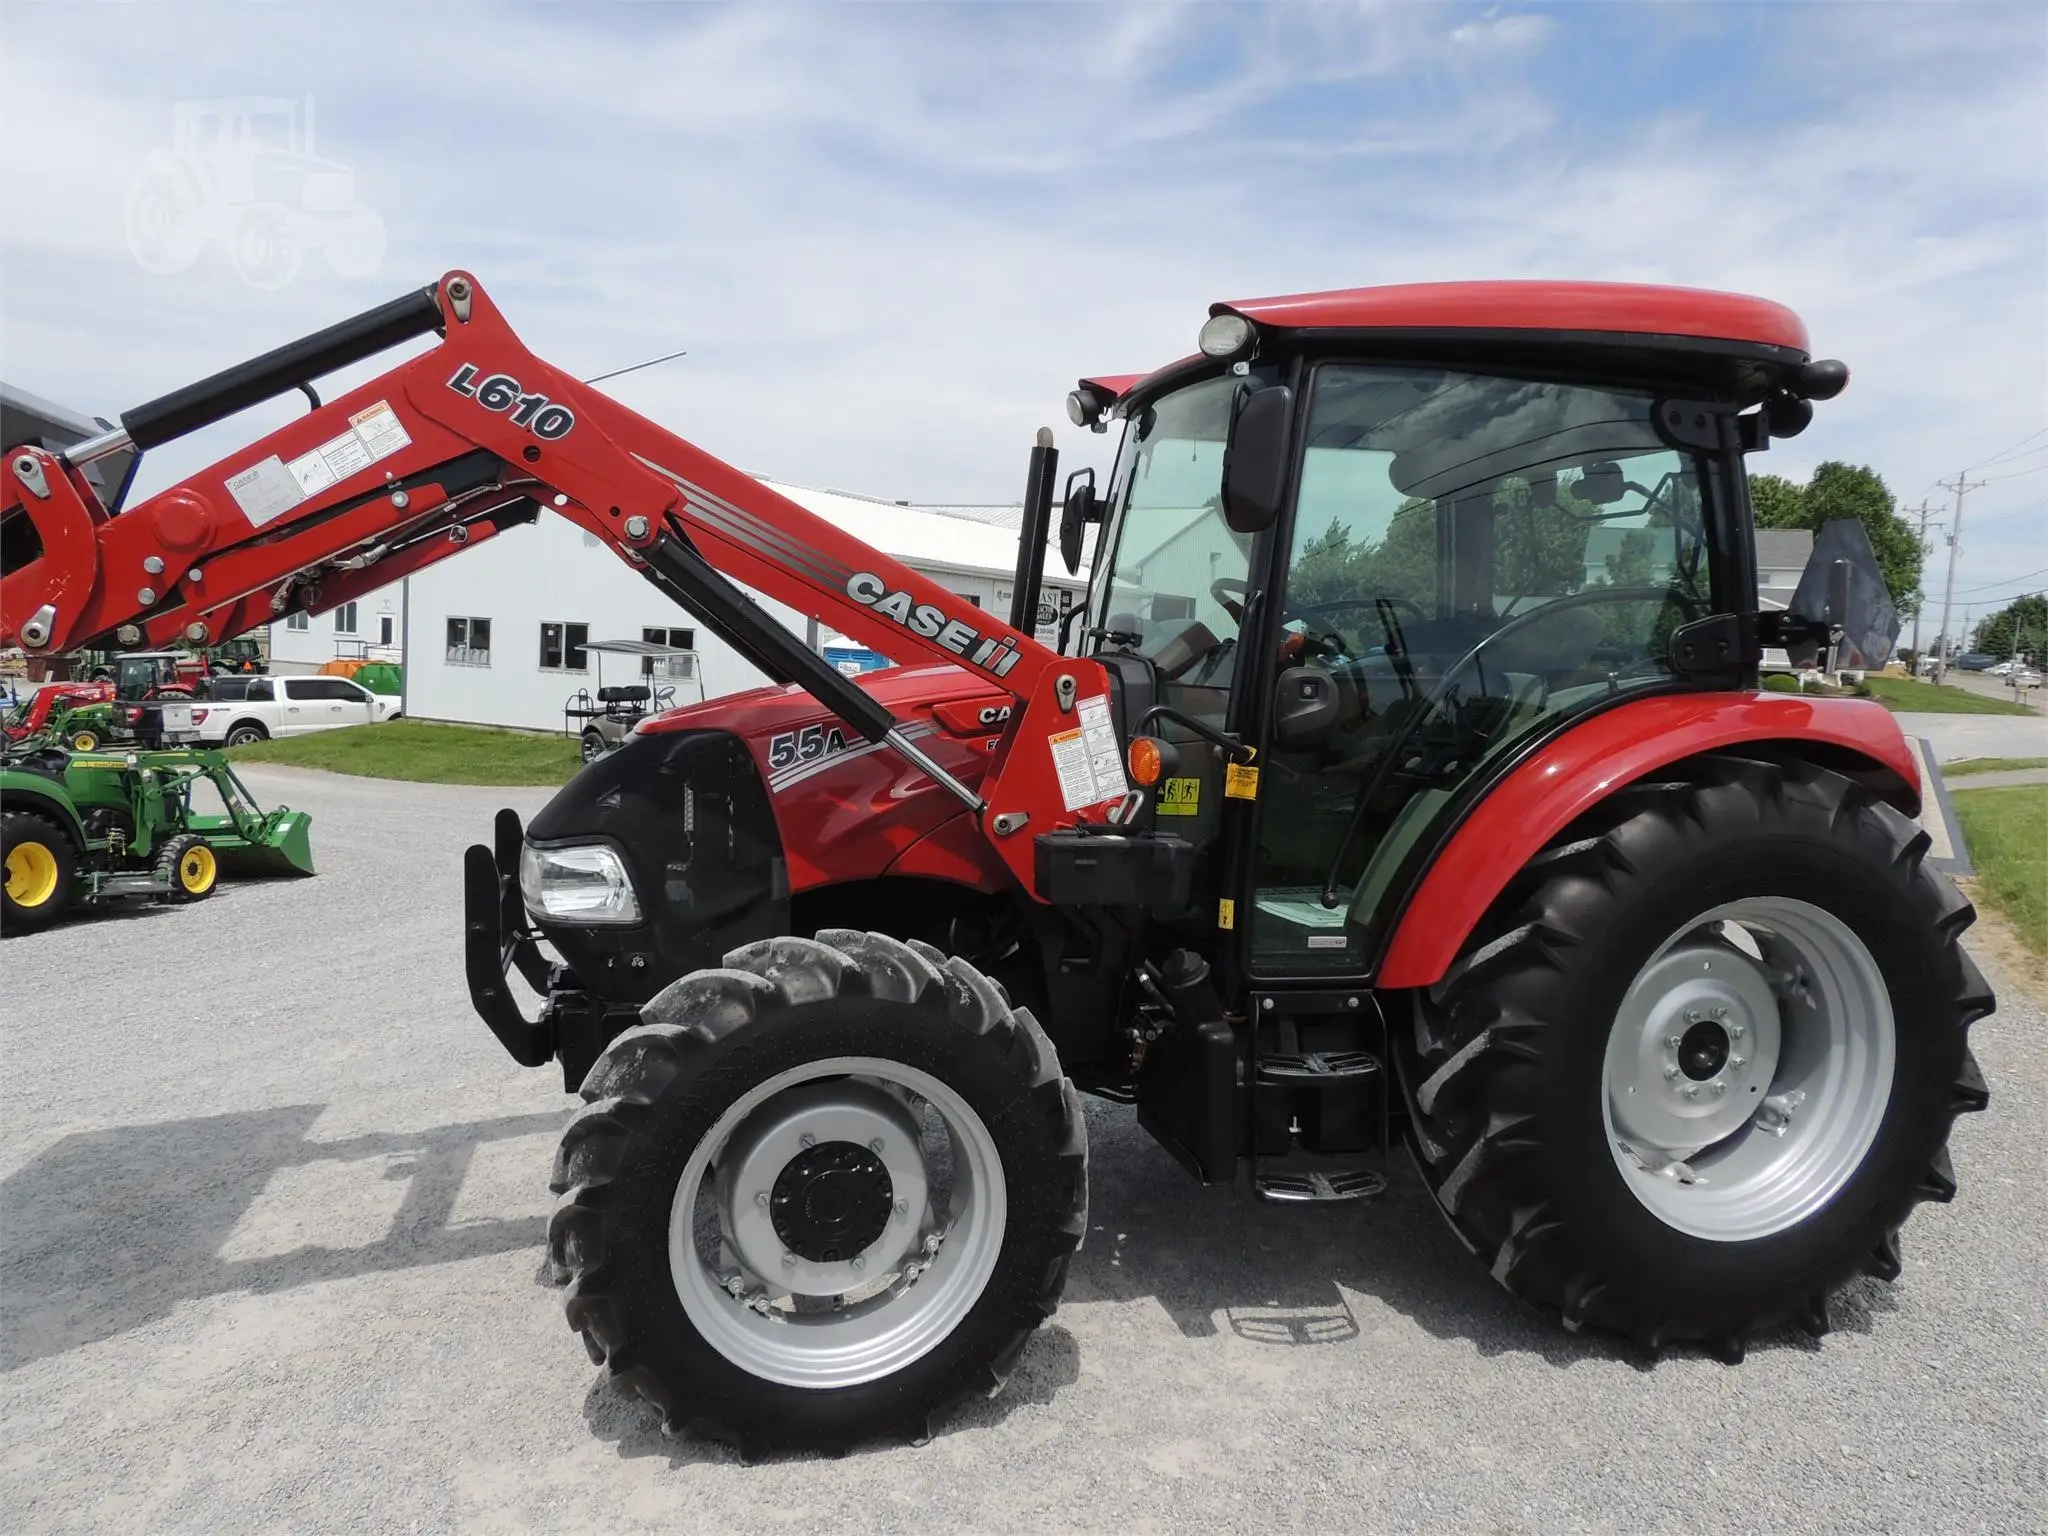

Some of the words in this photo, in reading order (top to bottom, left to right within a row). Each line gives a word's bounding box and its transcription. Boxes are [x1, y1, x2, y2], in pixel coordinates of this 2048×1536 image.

[446, 362, 575, 440] L610
[846, 572, 981, 655] CASE
[1039, 591, 1058, 605] AST
[767, 723, 849, 769] 55A
